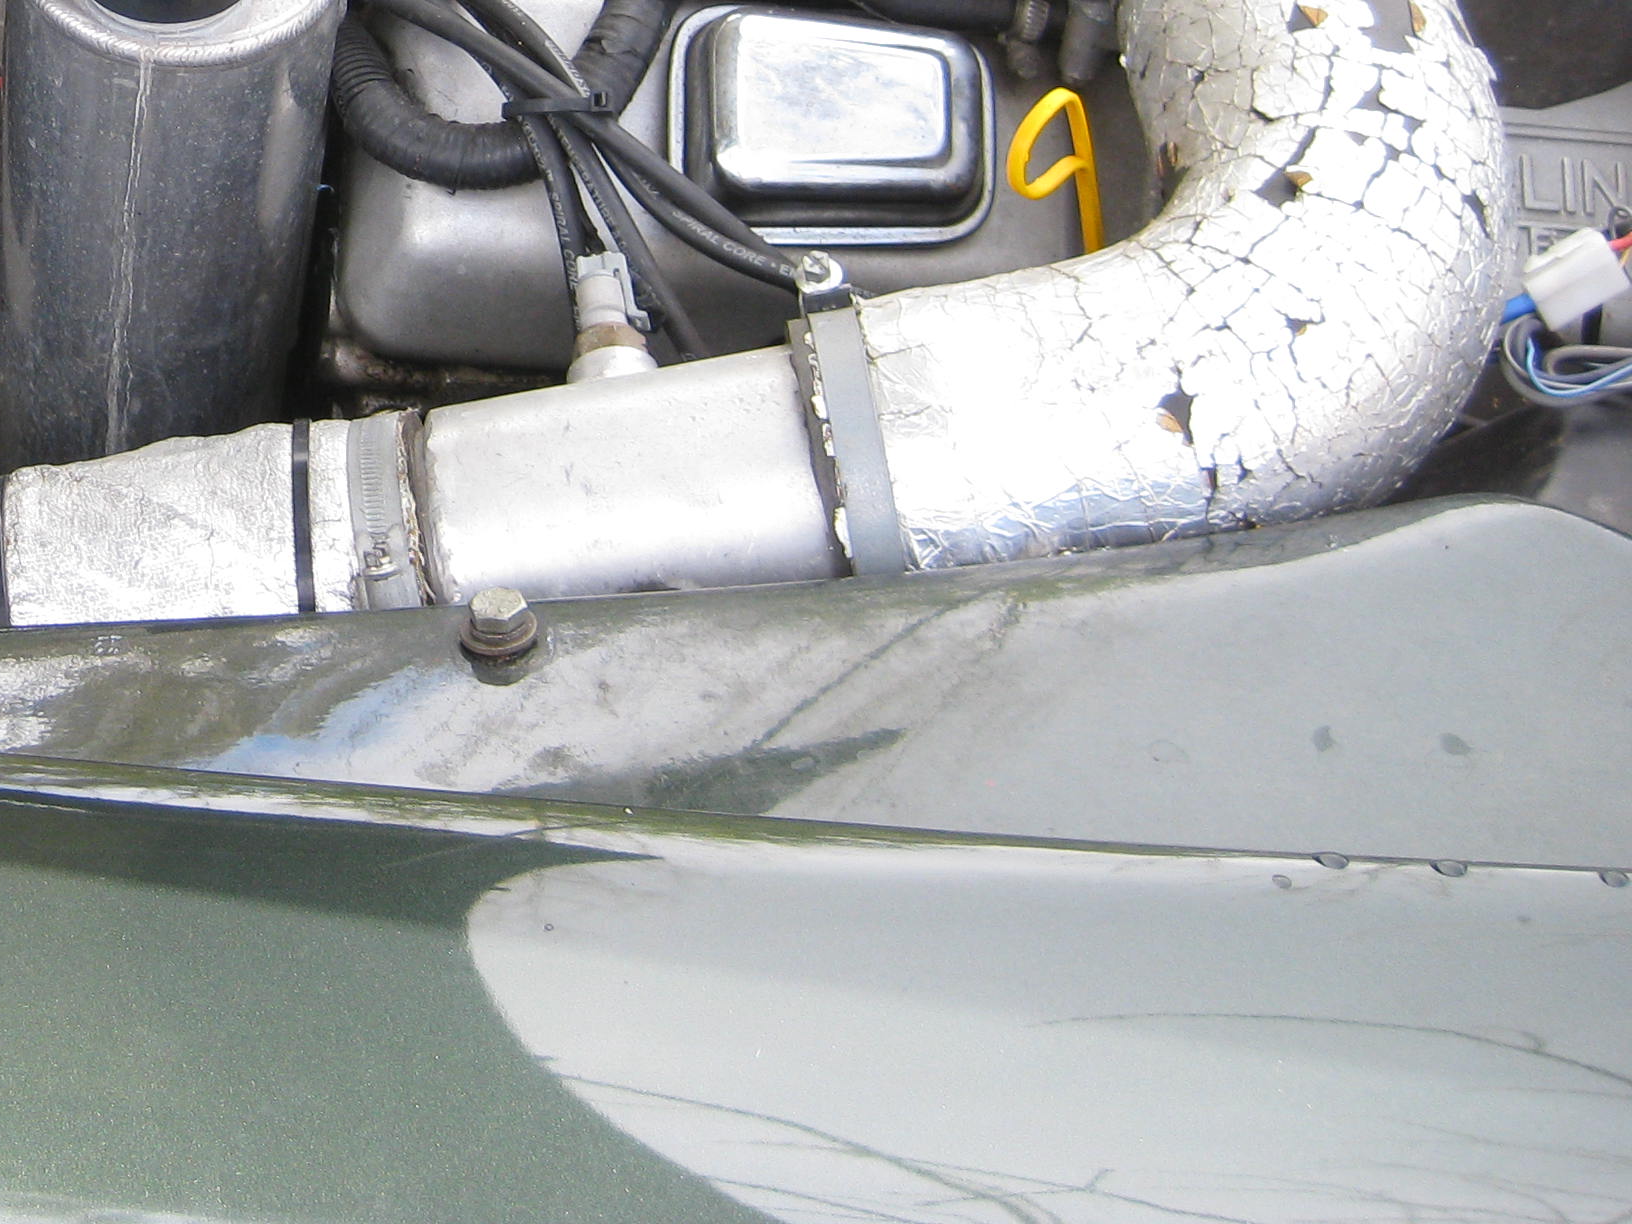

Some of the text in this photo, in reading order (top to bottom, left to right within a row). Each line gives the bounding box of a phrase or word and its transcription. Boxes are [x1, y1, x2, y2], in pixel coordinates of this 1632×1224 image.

[552, 190, 571, 244] SPIRAL
[671, 209, 720, 245] SPIRAL
[722, 241, 766, 267] CORE
